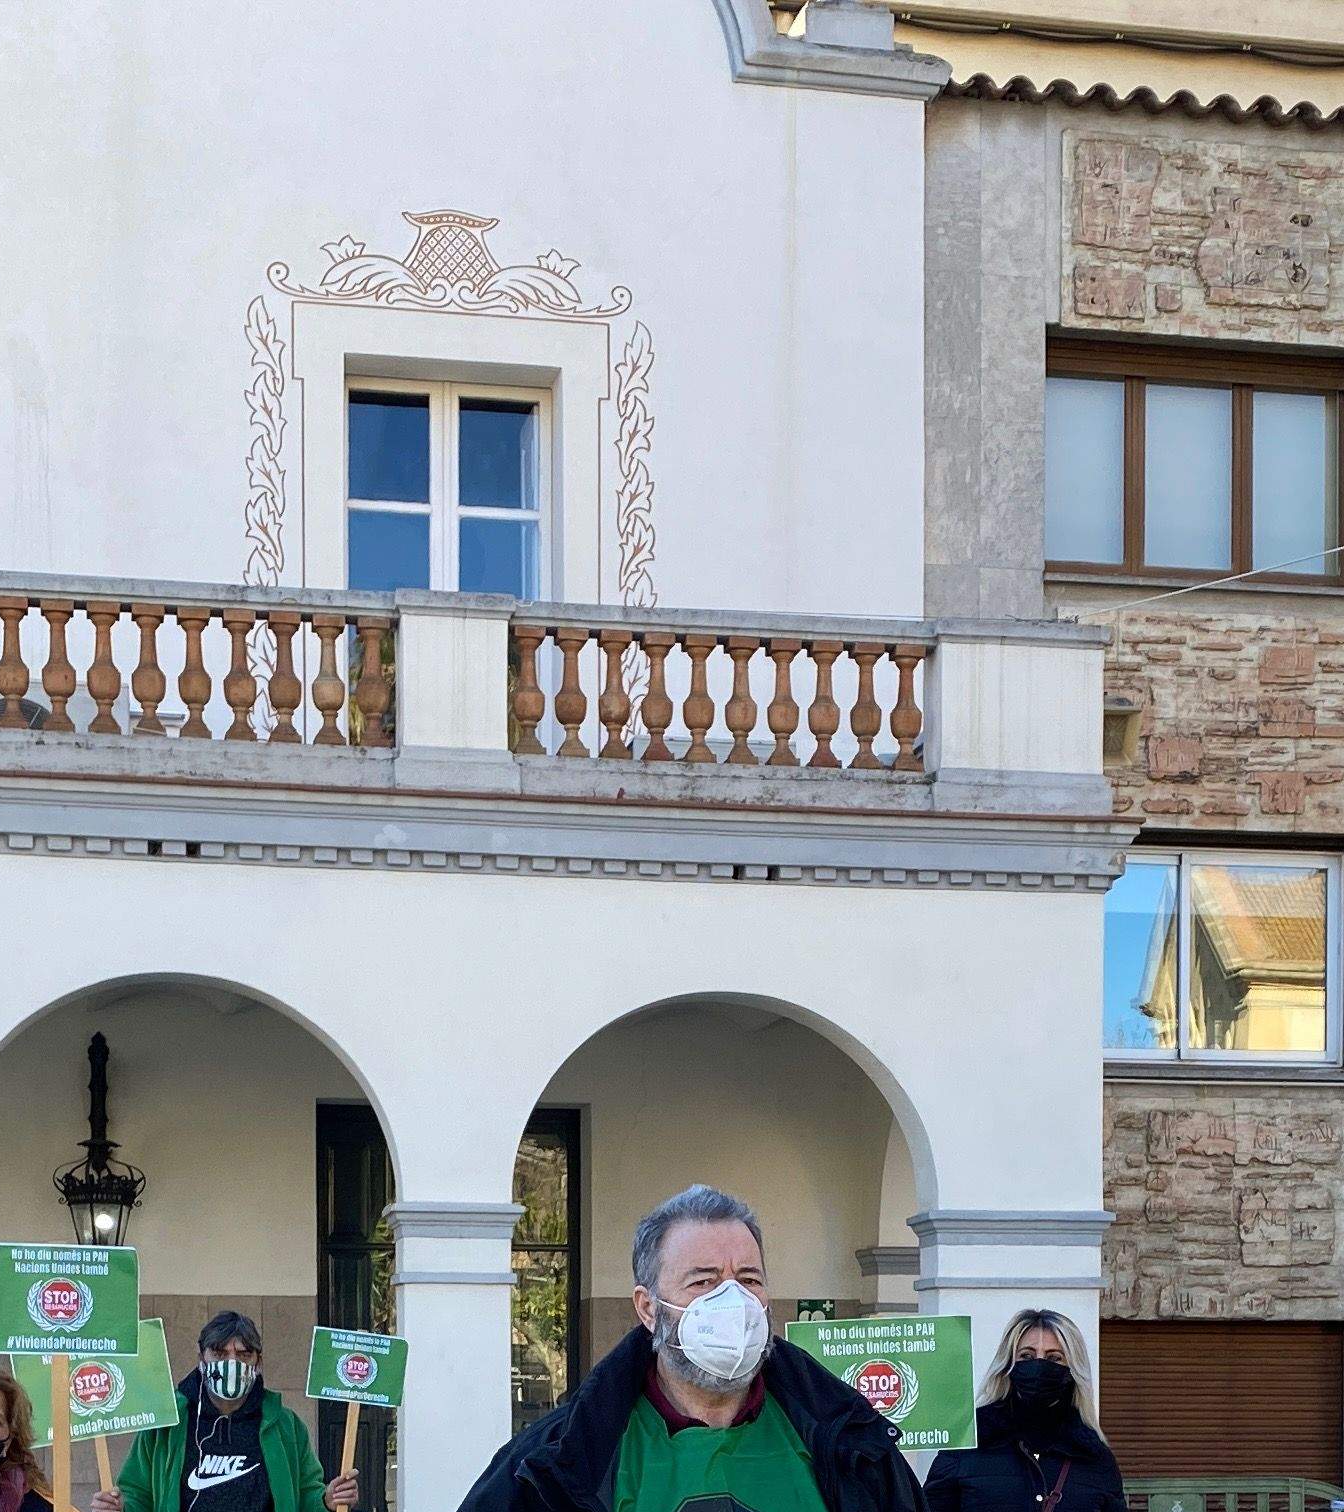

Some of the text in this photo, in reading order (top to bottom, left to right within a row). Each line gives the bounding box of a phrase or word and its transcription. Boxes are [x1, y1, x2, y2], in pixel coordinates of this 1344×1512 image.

[11, 1249, 109, 1262] No ho diu només la PAH
[15, 1262, 109, 1275] Nacions Unides també
[44, 1290, 78, 1304] STOP
[818, 1323, 935, 1340] No ho diu només la PAH
[7, 1335, 117, 1350] #ViviendaPorDerecho
[822, 1338, 936, 1356] Nacions Unides també
[347, 1360, 369, 1371] STOP
[75, 1372, 108, 1390] STOP
[859, 1374, 899, 1391] STOP
[47, 1412, 156, 1440] #iendaPorDerecho
[198, 1454, 247, 1474] NIKE
